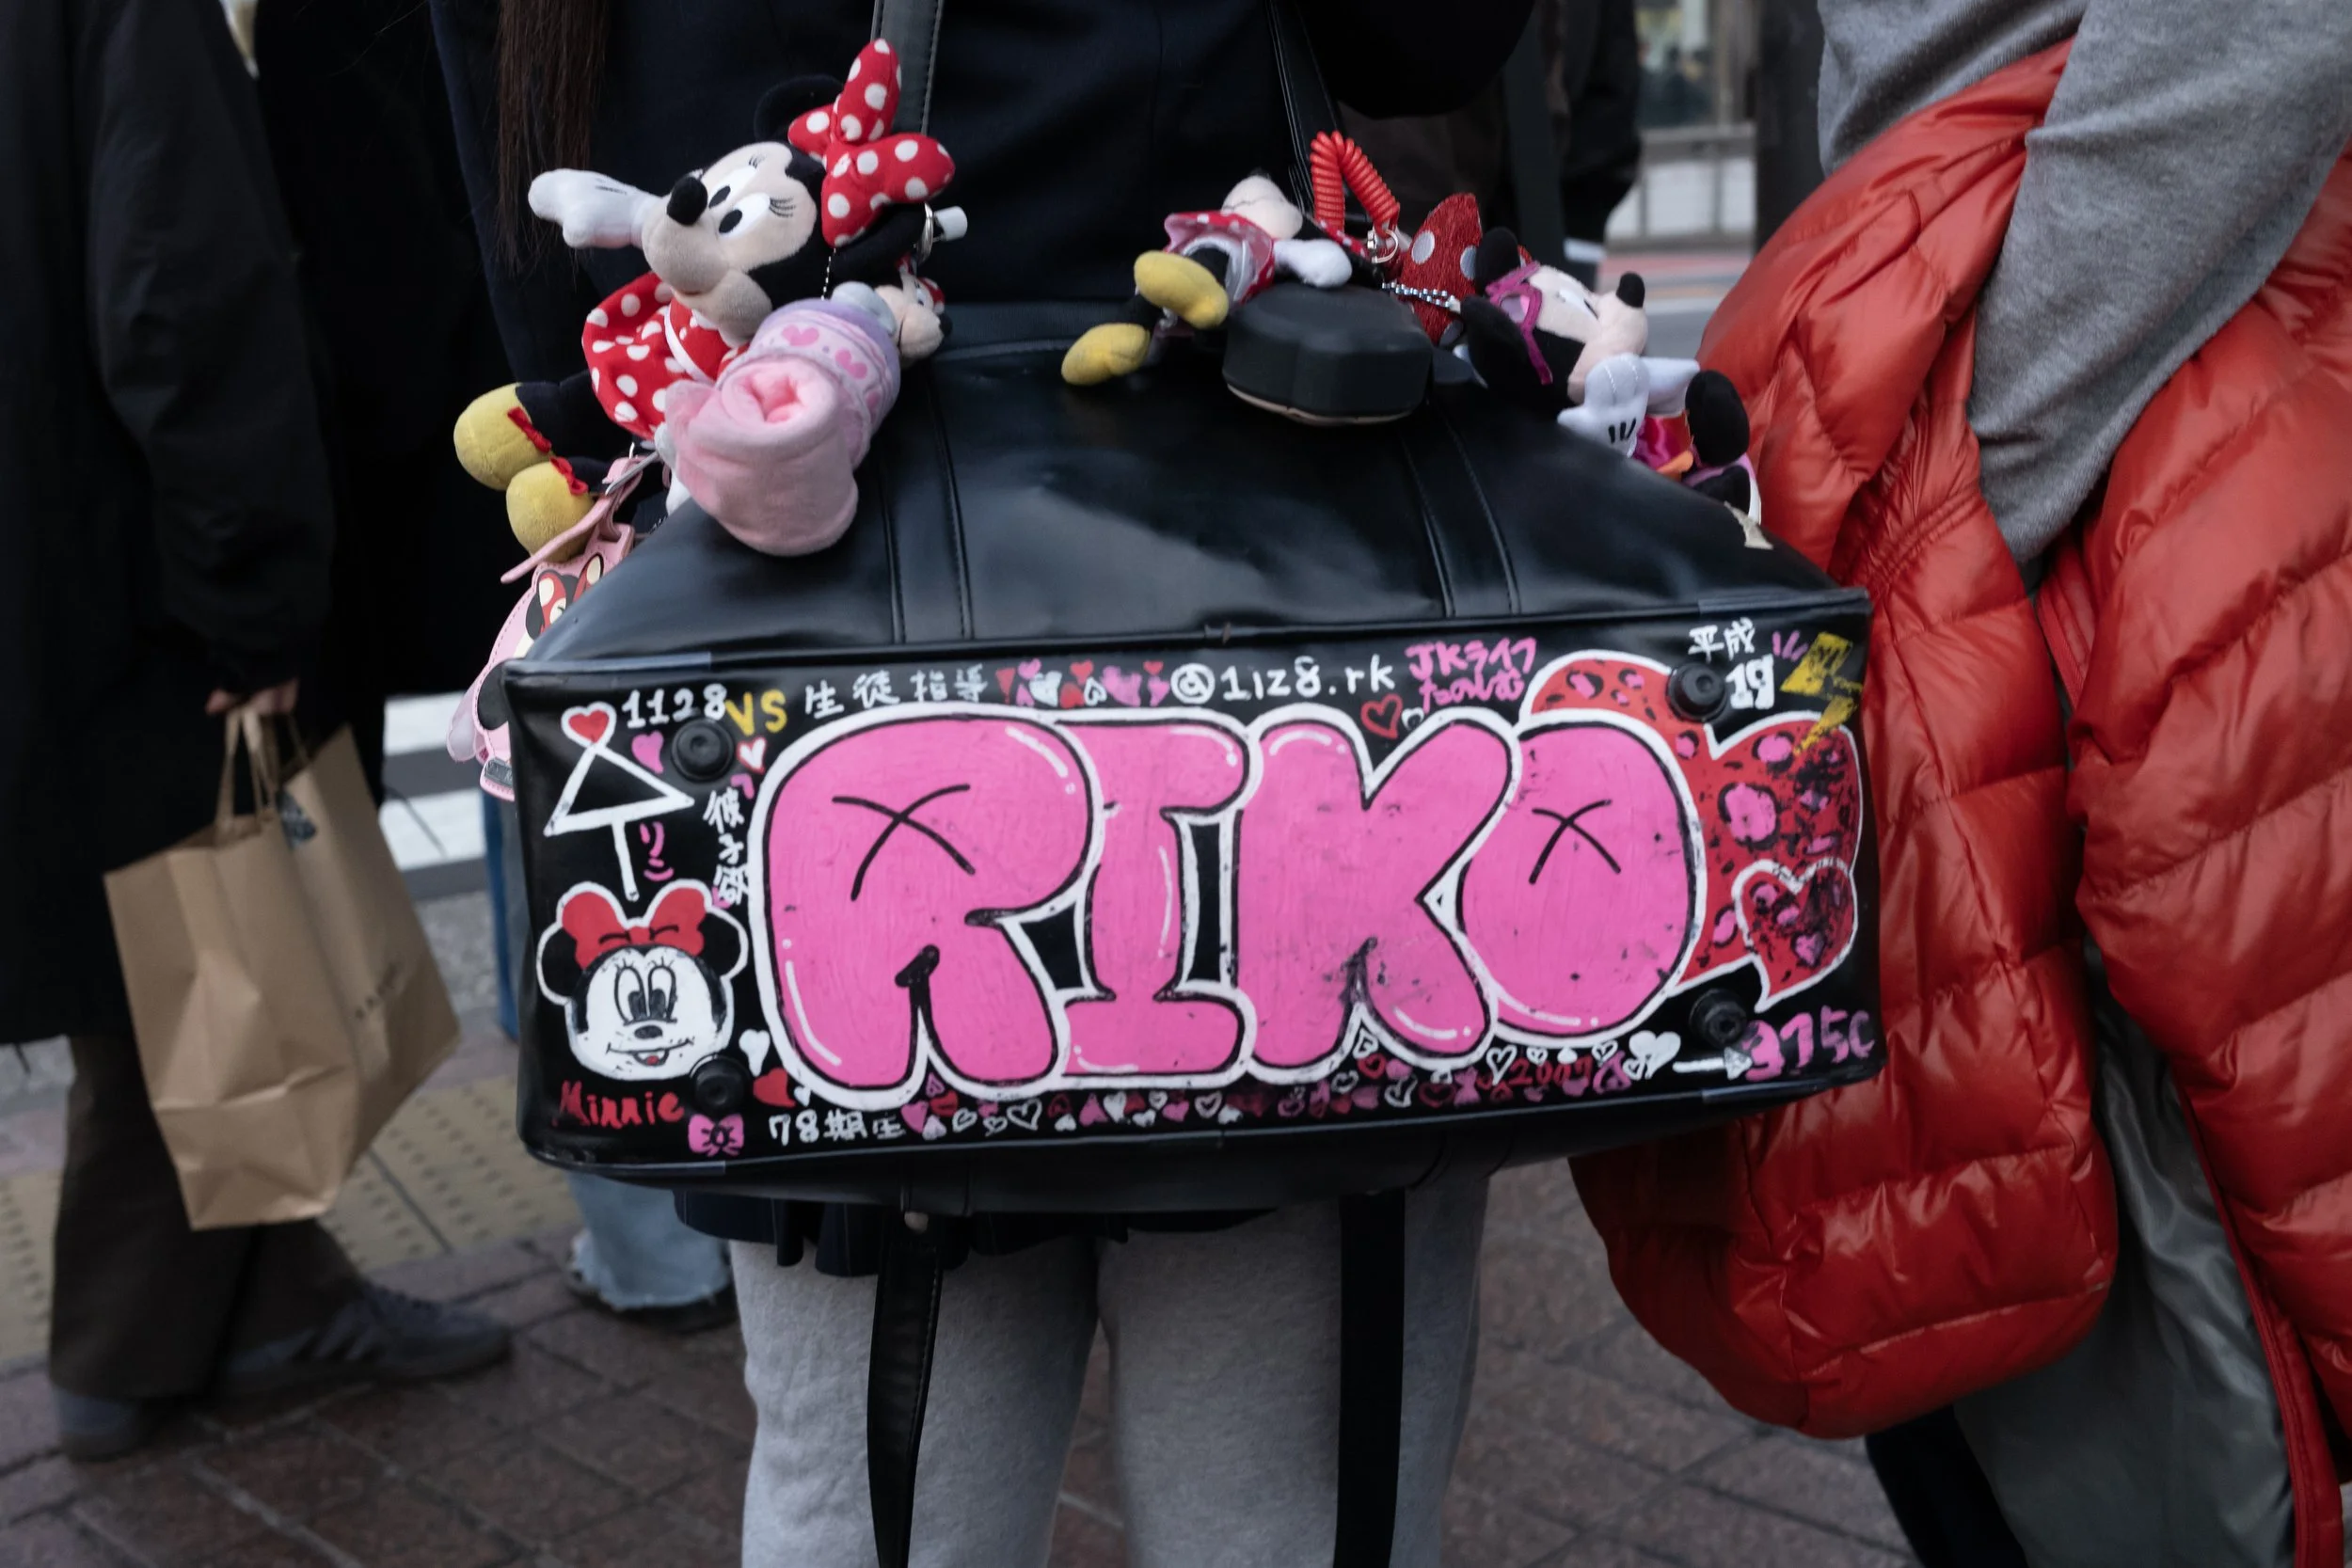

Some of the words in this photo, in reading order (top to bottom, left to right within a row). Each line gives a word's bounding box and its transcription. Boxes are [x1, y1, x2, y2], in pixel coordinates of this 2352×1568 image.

[1688, 617, 1755, 662] 平成
[622, 683, 726, 728] 1128
[725, 689, 787, 736] VS
[805, 663, 987, 719] 生徒指導
[1725, 654, 1774, 709] 19
[749, 702, 1707, 1110] RIKO
[1508, 1053, 1595, 1087] 2007
[551, 1079, 685, 1129] Minnie
